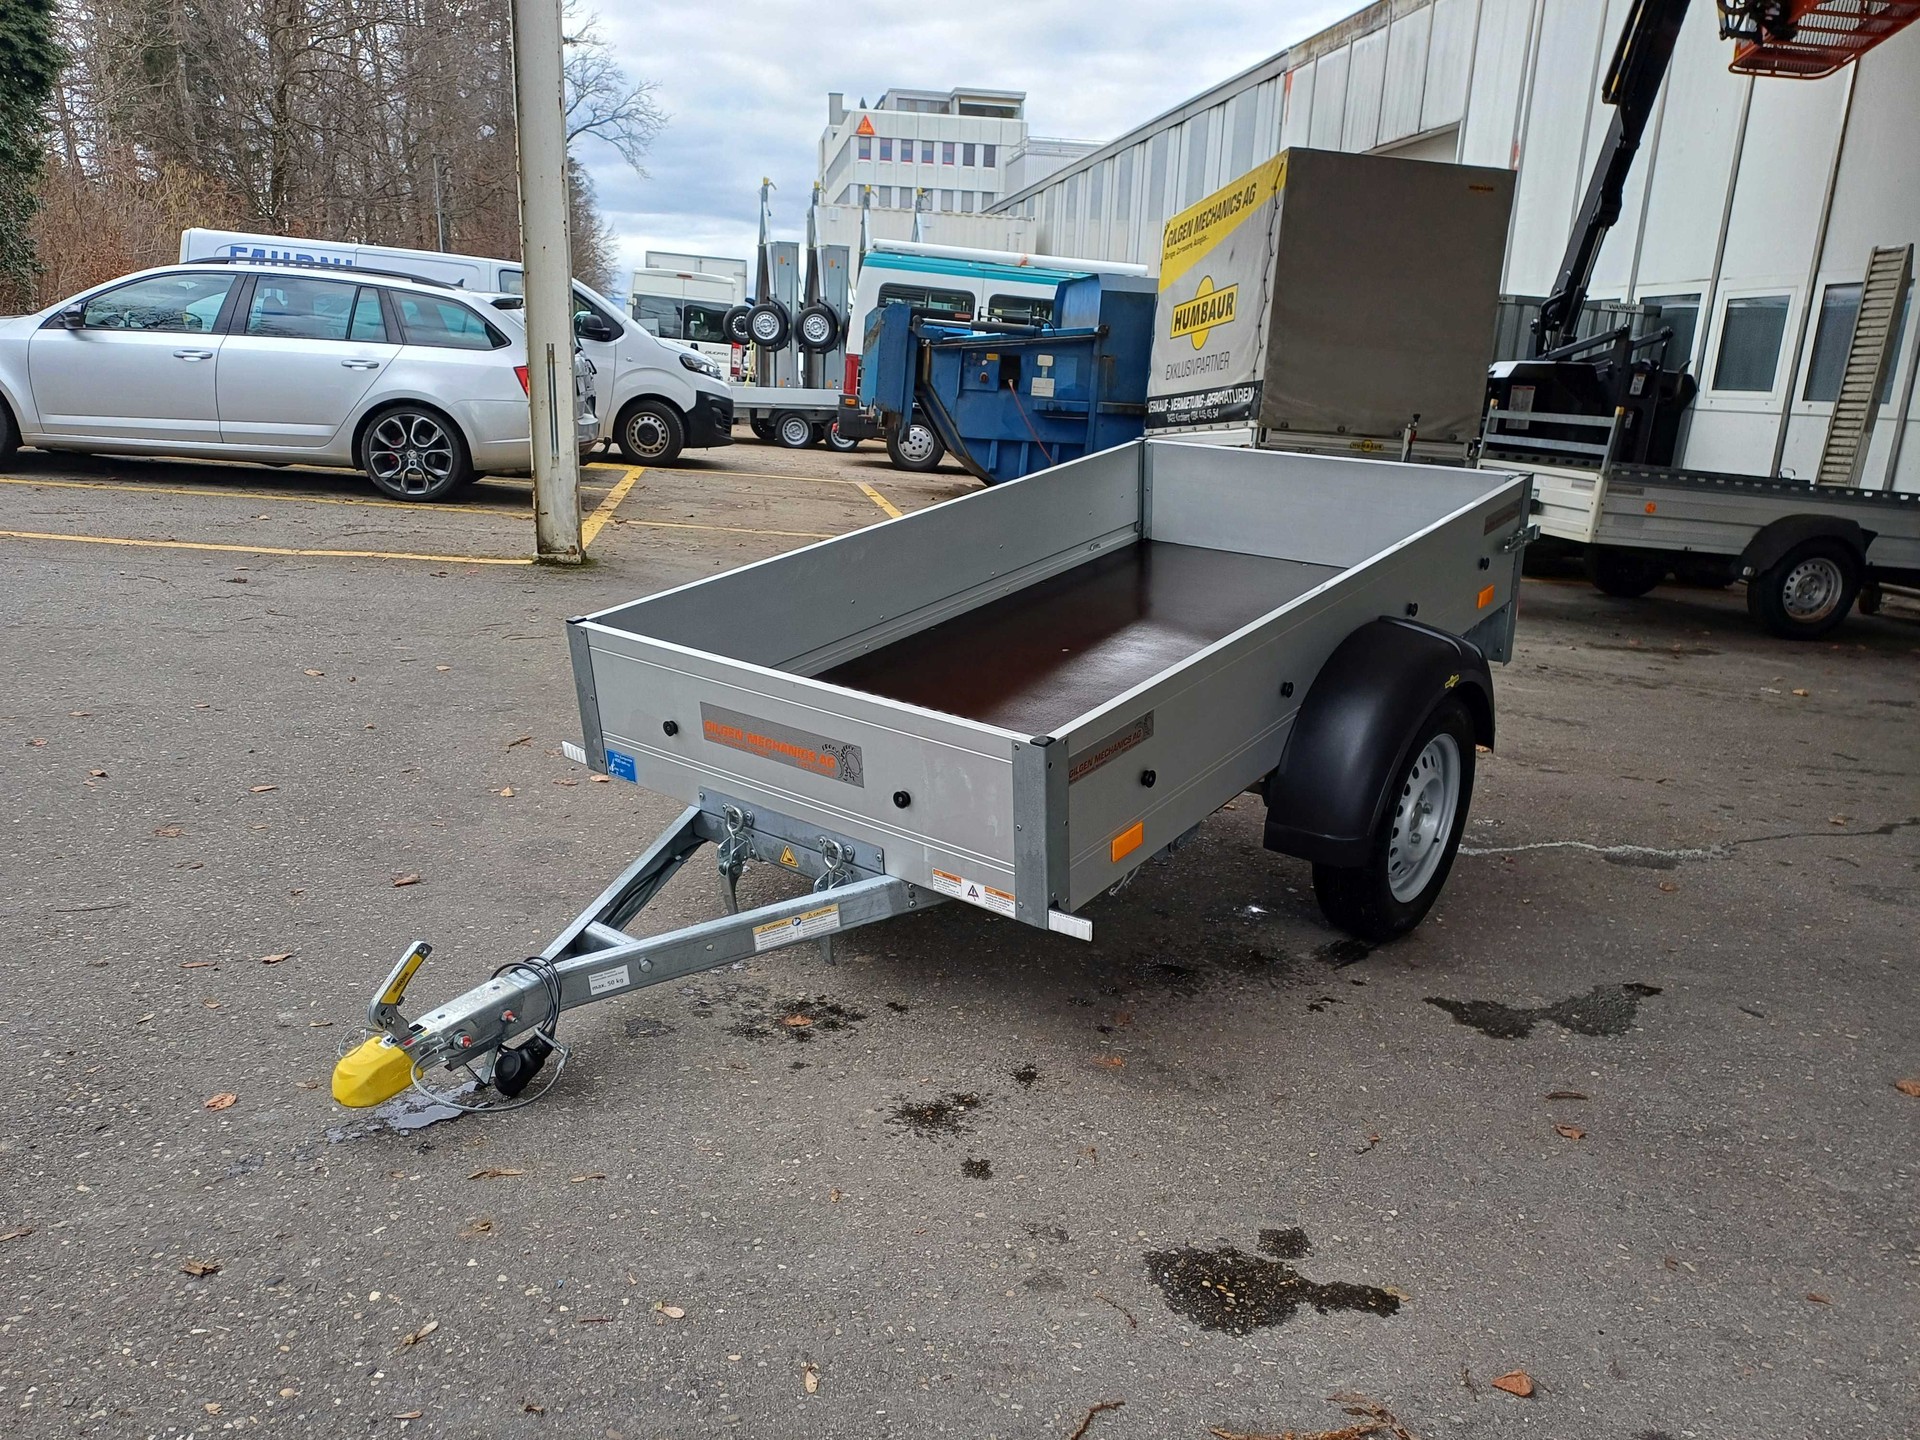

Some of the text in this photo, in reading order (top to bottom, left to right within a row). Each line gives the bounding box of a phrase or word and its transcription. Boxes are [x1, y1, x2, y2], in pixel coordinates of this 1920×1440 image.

[1166, 182, 1257, 248] GILGEN MECHANICS AG
[1173, 292, 1234, 332] HUMBAUR
[1609, 303, 1637, 311] WANNER
[1165, 351, 1230, 381] EXKLUSIVPARTNER
[704, 719, 743, 741] GILGEN
[747, 732, 817, 763] MECHANICS
[819, 755, 836, 769] AG
[1069, 759, 1093, 779] GILGEN
[1094, 735, 1132, 763] MECHANICS
[1132, 728, 1142, 741] AG
